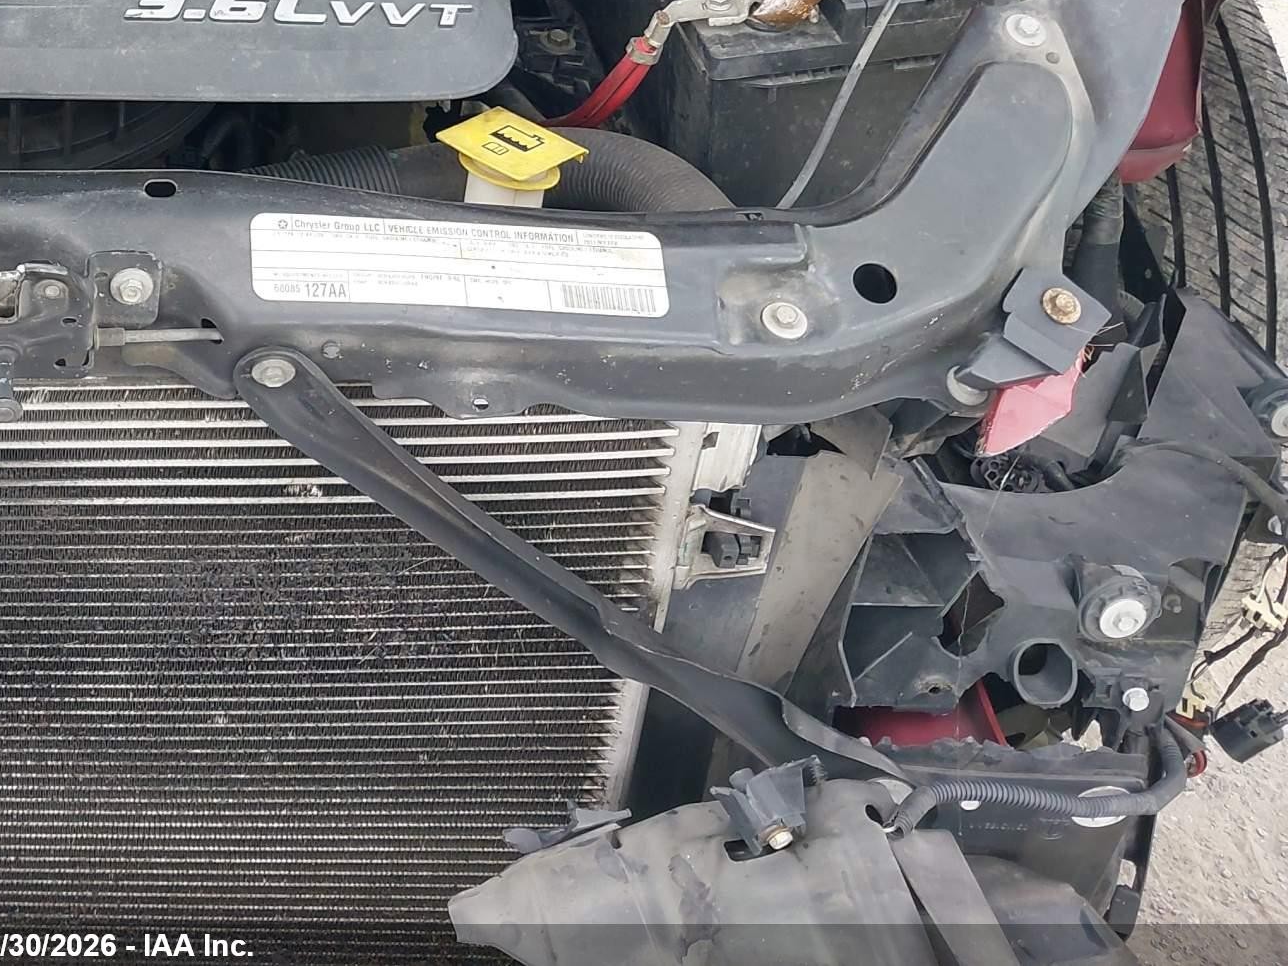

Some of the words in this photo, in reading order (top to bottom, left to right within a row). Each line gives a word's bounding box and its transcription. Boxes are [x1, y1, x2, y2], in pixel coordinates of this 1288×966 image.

[294, 219, 331, 230] Chrysler
[334, 221, 360, 232] Group
[364, 222, 381, 232] LLC
[387, 224, 423, 234] VEHICLE
[426, 226, 468, 237] EMISSION
[471, 228, 512, 239] CONTROL
[514, 231, 574, 243] INFORMATION
[305, 282, 347, 298] 127AA
